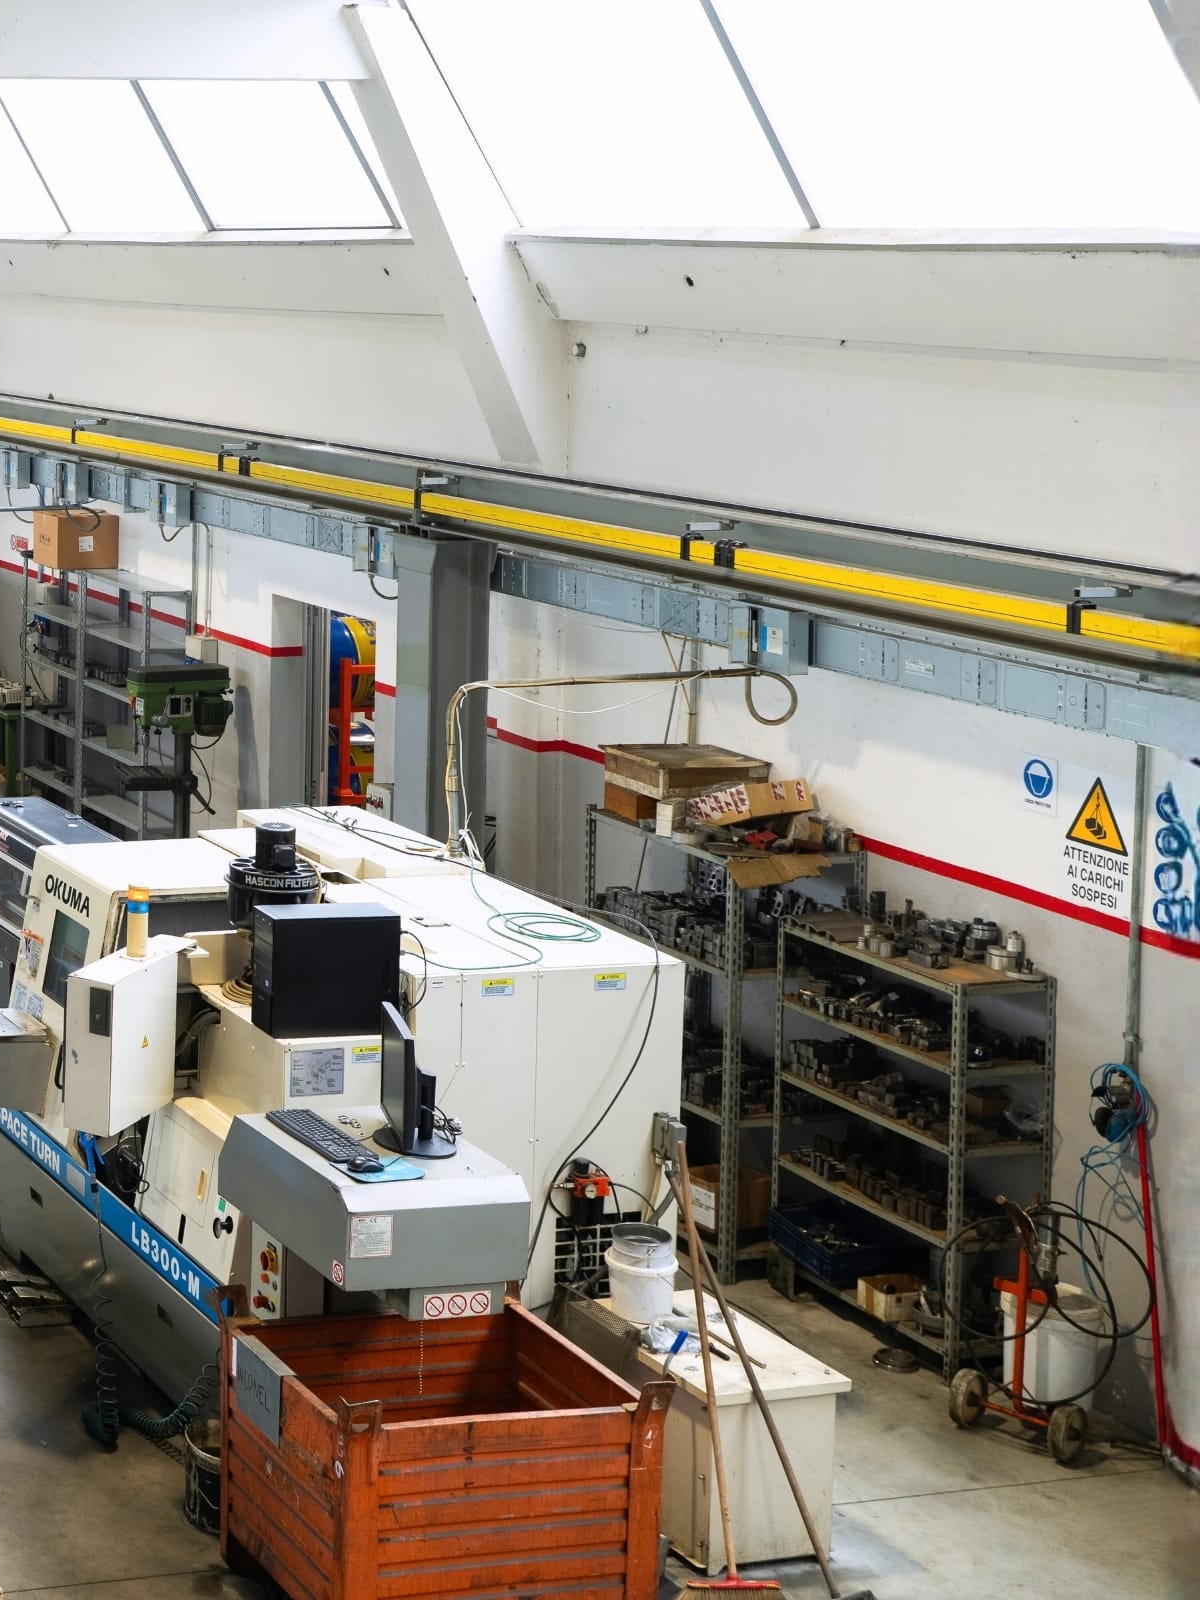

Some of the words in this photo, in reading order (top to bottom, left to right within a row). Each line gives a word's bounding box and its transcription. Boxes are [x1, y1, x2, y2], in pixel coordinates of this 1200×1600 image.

[1063, 845, 1129, 876] ATTENZIONE
[1067, 864, 1078, 879] AI
[1080, 868, 1124, 893] CARICHI
[44, 873, 90, 918] OKUMA
[245, 874, 284, 888] HASCON
[1071, 883, 1117, 909] SOSPESI
[29, 1130, 61, 1175] TURN
[131, 1221, 200, 1301] LB300-M
[237, 1365, 272, 1413] NCONEL
